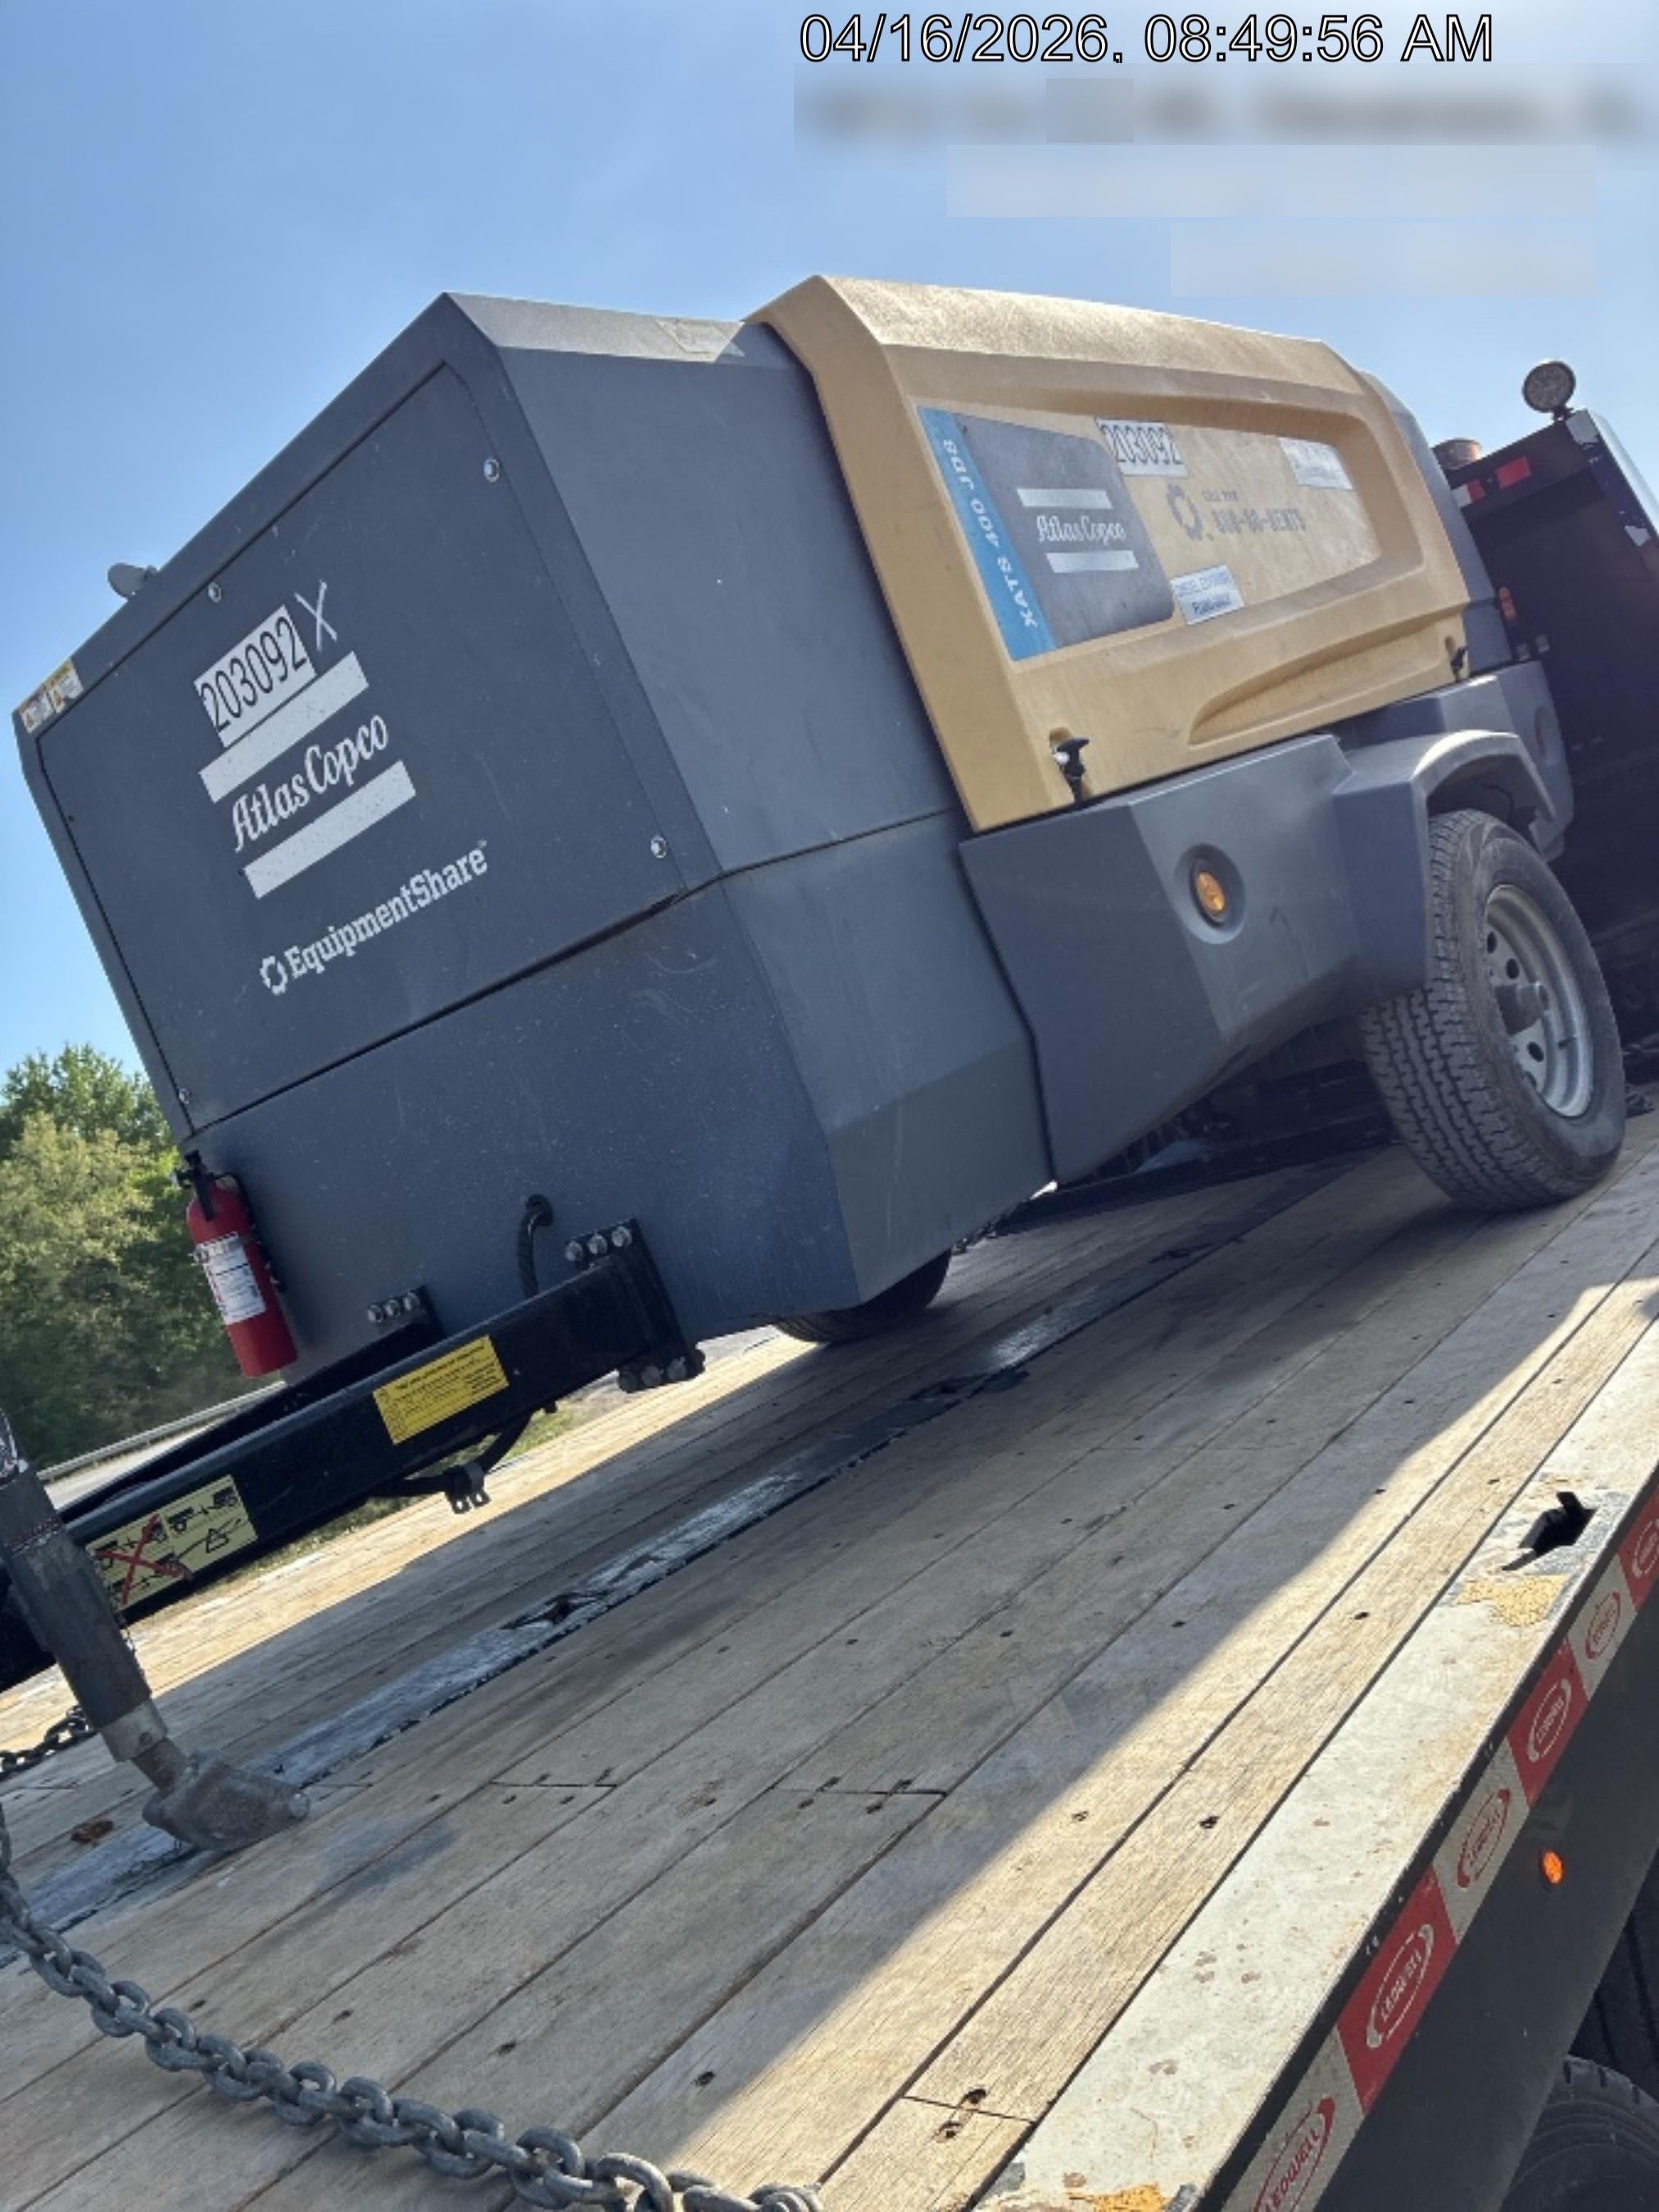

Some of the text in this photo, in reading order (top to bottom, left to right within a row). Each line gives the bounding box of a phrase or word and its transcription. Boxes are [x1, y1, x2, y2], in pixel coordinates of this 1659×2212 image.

[1099, 424, 1183, 465] 203092
[970, 498, 1000, 549] 400
[997, 556, 1038, 628] XATS
[199, 616, 310, 732] 203092
[284, 846, 488, 979] EquipmentShare
